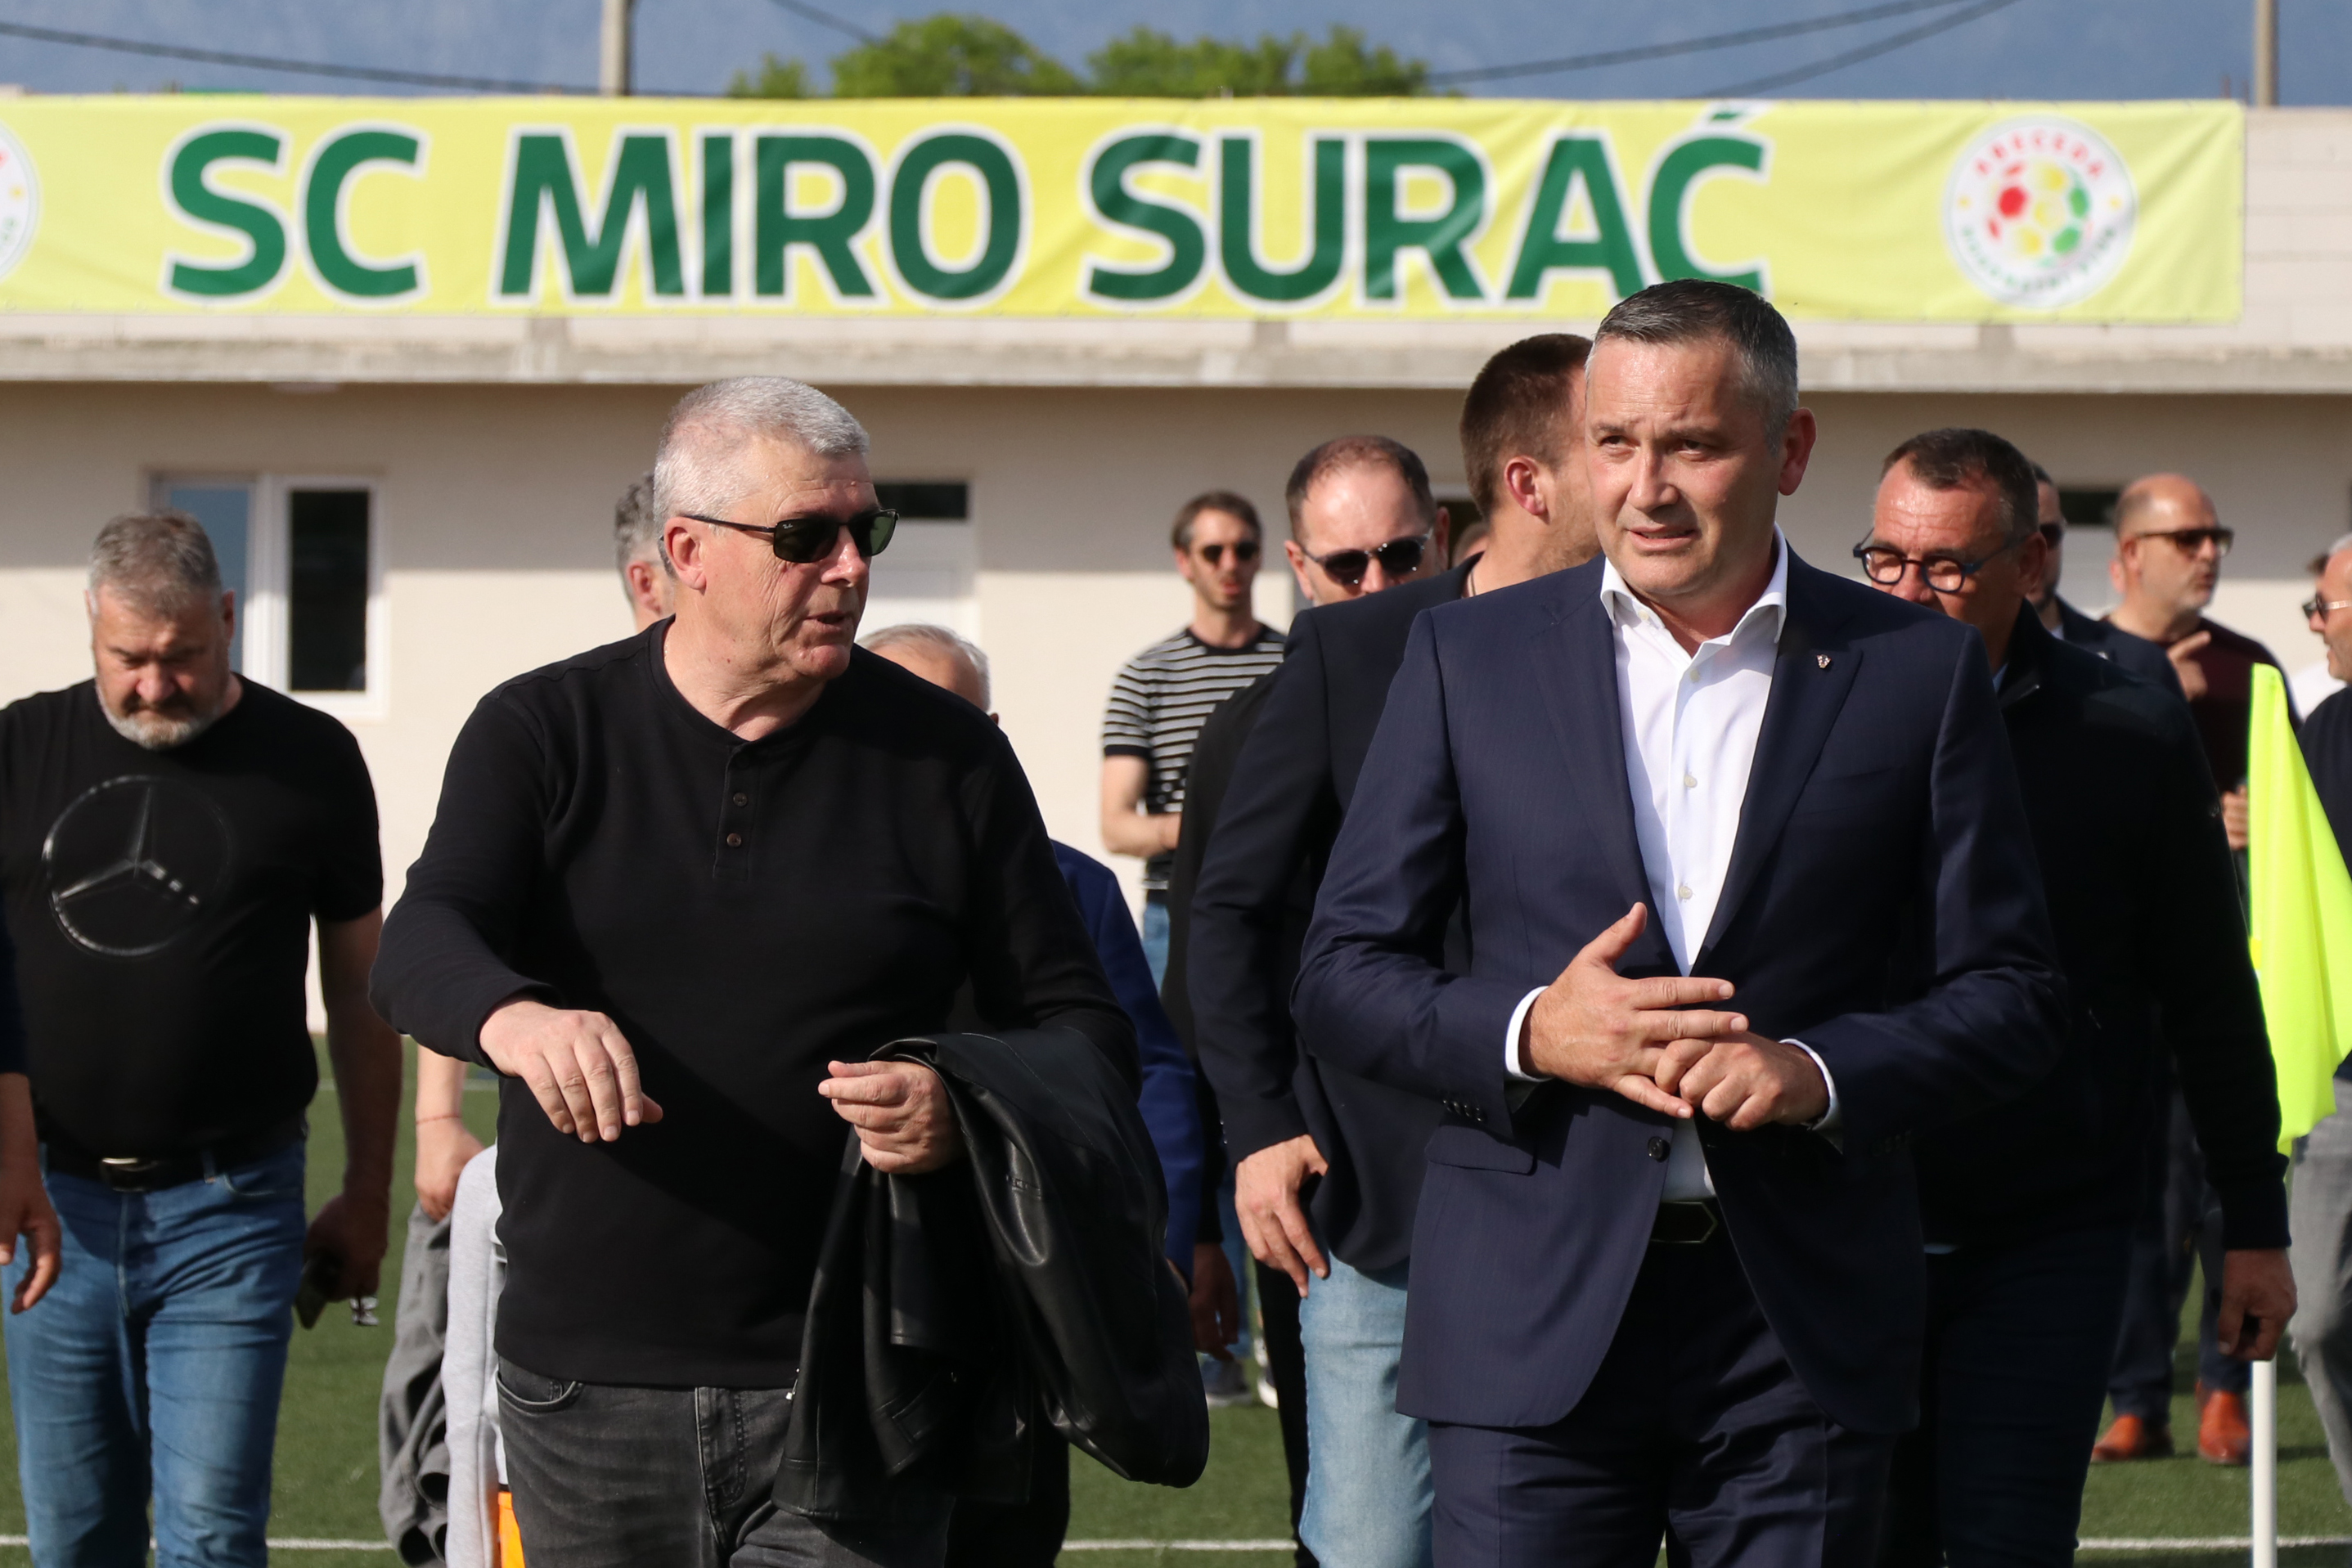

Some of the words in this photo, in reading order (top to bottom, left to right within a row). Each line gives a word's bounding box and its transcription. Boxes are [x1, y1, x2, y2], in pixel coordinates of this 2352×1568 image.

[170, 130, 419, 298] SC
[500, 133, 1021, 301] MIRO
[1090, 111, 1765, 302] SURAĆ
